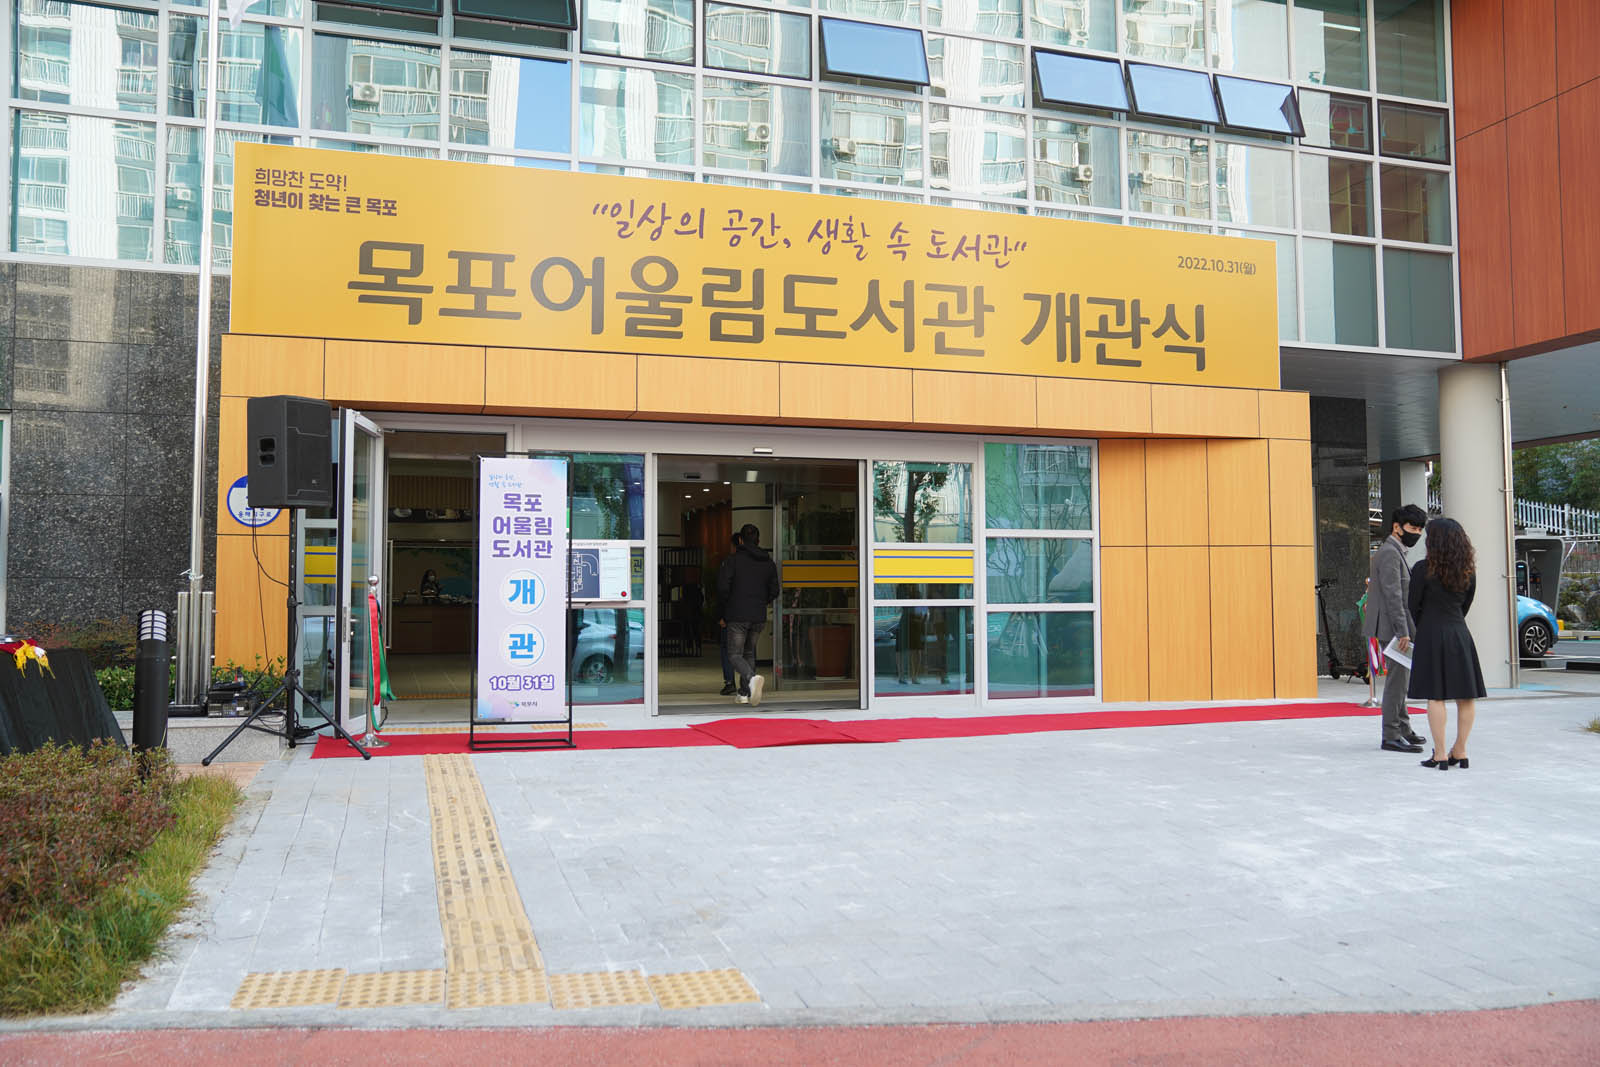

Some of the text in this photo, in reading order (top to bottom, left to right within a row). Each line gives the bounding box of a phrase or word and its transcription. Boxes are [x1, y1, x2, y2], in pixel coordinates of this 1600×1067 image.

[254, 167, 347, 192] 희망찬 도약!
[254, 188, 398, 217] 청년이 찾는 큰 목포
[721, 208, 792, 250] 공간,
[807, 215, 871, 262] 생활
[886, 221, 912, 262] 속
[1177, 255, 1257, 275] 2022.10.31(월)
[347, 239, 1206, 372] 목포어울림도서관 개관식
[503, 493, 542, 512] 목포
[492, 516, 553, 537] 어울림
[492, 539, 553, 559] 도서관
[507, 578, 537, 660] 개 관
[489, 674, 555, 691] 10월 31일
